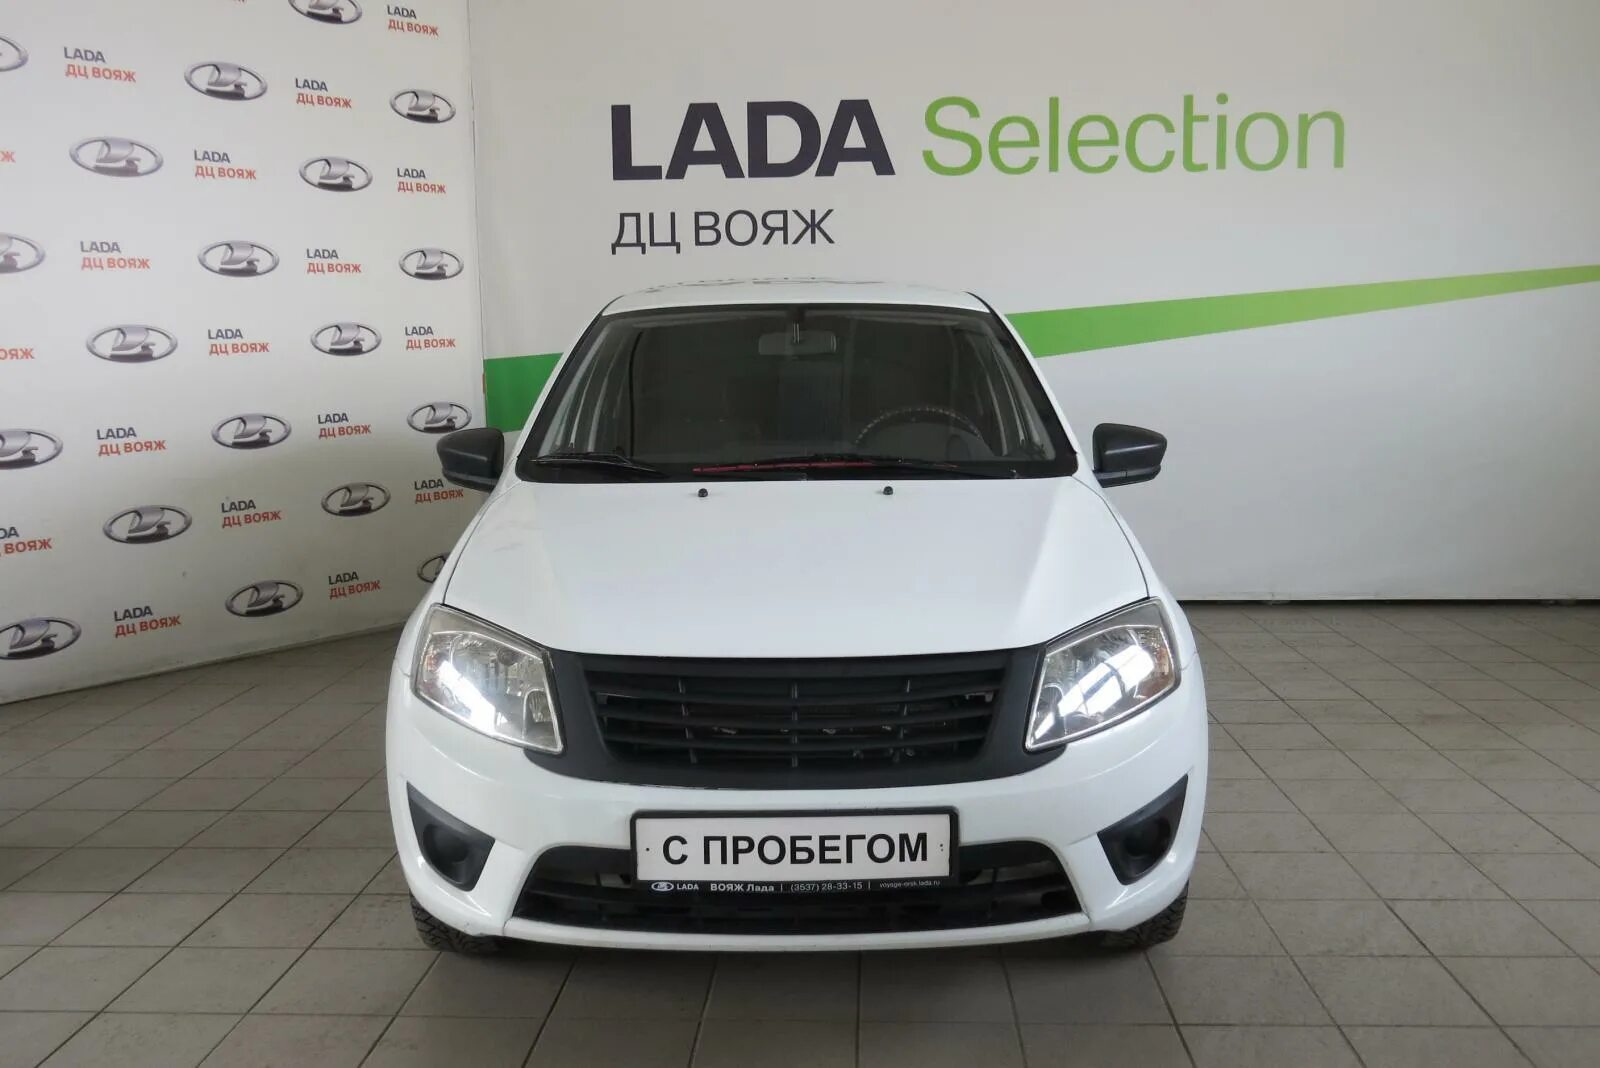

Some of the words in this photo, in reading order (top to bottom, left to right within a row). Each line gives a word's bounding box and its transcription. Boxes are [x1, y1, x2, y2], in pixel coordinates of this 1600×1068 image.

[387, 5, 417, 20] LADA
[388, 20, 406, 33] ДЦ
[407, 22, 439, 36] ВОЯЖ
[64, 47, 106, 63] LADA
[65, 64, 88, 79] ДЦ
[92, 66, 136, 83] ВОЯЖ
[295, 78, 328, 92] LADA
[296, 93, 315, 106] ДЦ
[317, 95, 352, 108] ВОЯЖ
[611, 99, 896, 181] LADA
[922, 93, 1345, 176] Selection
[194, 149, 231, 164] LADA
[195, 165, 216, 180] ДЦ
[218, 166, 257, 180] ВОЯЖ
[397, 167, 426, 179] LADA
[397, 181, 415, 193] ДЦ
[416, 182, 446, 194] ВОЯЖ
[611, 211, 680, 255] ДЦ
[694, 208, 835, 247] ВОЯЖ
[80, 241, 121, 253] LADA
[306, 248, 339, 259] LADA
[81, 257, 104, 271] ДЦ
[107, 257, 151, 269] ВОЯЖ
[306, 262, 326, 275] ДЦ
[327, 263, 362, 273] ВОЯЖ
[207, 328, 243, 340] LADA
[405, 326, 434, 336] LADA
[208, 344, 229, 356] ДЦ
[231, 342, 270, 354] ВОЯЖ
[406, 339, 422, 350] ДЦ
[424, 338, 456, 349] ВОЯЖ
[317, 412, 349, 424] LADA
[96, 427, 137, 440] LADA
[318, 428, 336, 440] ДЦ
[339, 424, 372, 436] ВОЯЖ
[98, 444, 121, 457] ДЦ
[124, 440, 166, 453] ВОЯЖ
[414, 479, 444, 491] LADA
[415, 493, 432, 504] ДЦ
[434, 488, 464, 501] ВОЯЖ
[221, 499, 256, 513] LADA
[221, 516, 242, 529] ДЦ
[244, 510, 282, 524] ВОЯЖ
[4, 538, 53, 554] ВОЯЖ
[328, 571, 359, 585] LADA
[329, 588, 347, 600] ДЦ
[349, 580, 381, 595] ВОЯЖ
[114, 605, 153, 622] LADA
[115, 625, 137, 638] ДЦ
[140, 615, 181, 632] ВОЯЖ
[662, 835, 688, 865] С
[703, 832, 928, 865] ПРОБЕГОМ
[676, 883, 700, 891] LADA
[710, 883, 744, 892] ВОЯЖ
[747, 883, 775, 893] Лада
[790, 882, 821, 893] (3537)
[822, 881, 863, 890] 28-33-15
